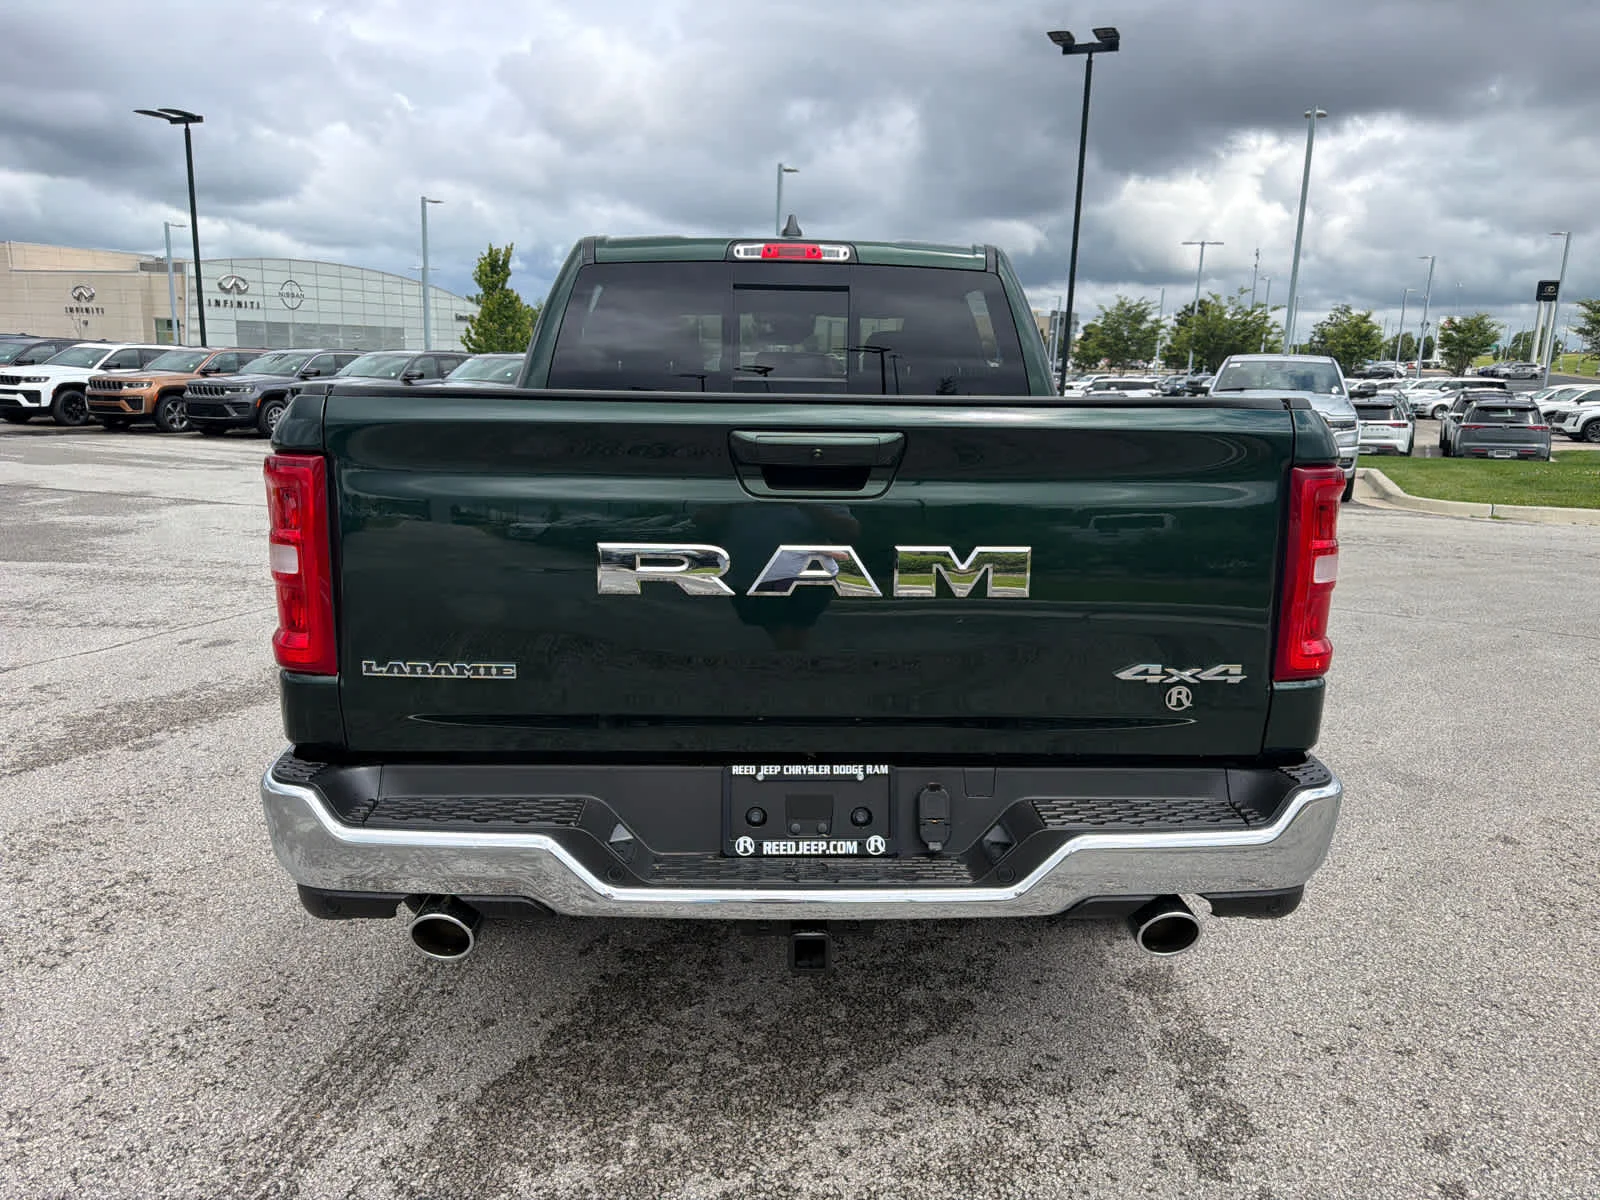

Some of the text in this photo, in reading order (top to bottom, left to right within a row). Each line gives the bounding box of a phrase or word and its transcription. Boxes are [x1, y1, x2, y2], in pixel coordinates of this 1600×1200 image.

[279, 291, 305, 299] NISSAN
[207, 299, 260, 310] INFINITI
[597, 542, 1032, 598] RAM
[362, 660, 517, 679] LARAMIE
[1113, 663, 1248, 684] 4x4
[732, 765, 889, 775] REED JEEP CHRYSLER DODGE RAM
[763, 841, 858, 855] REEDJEEP.COM
